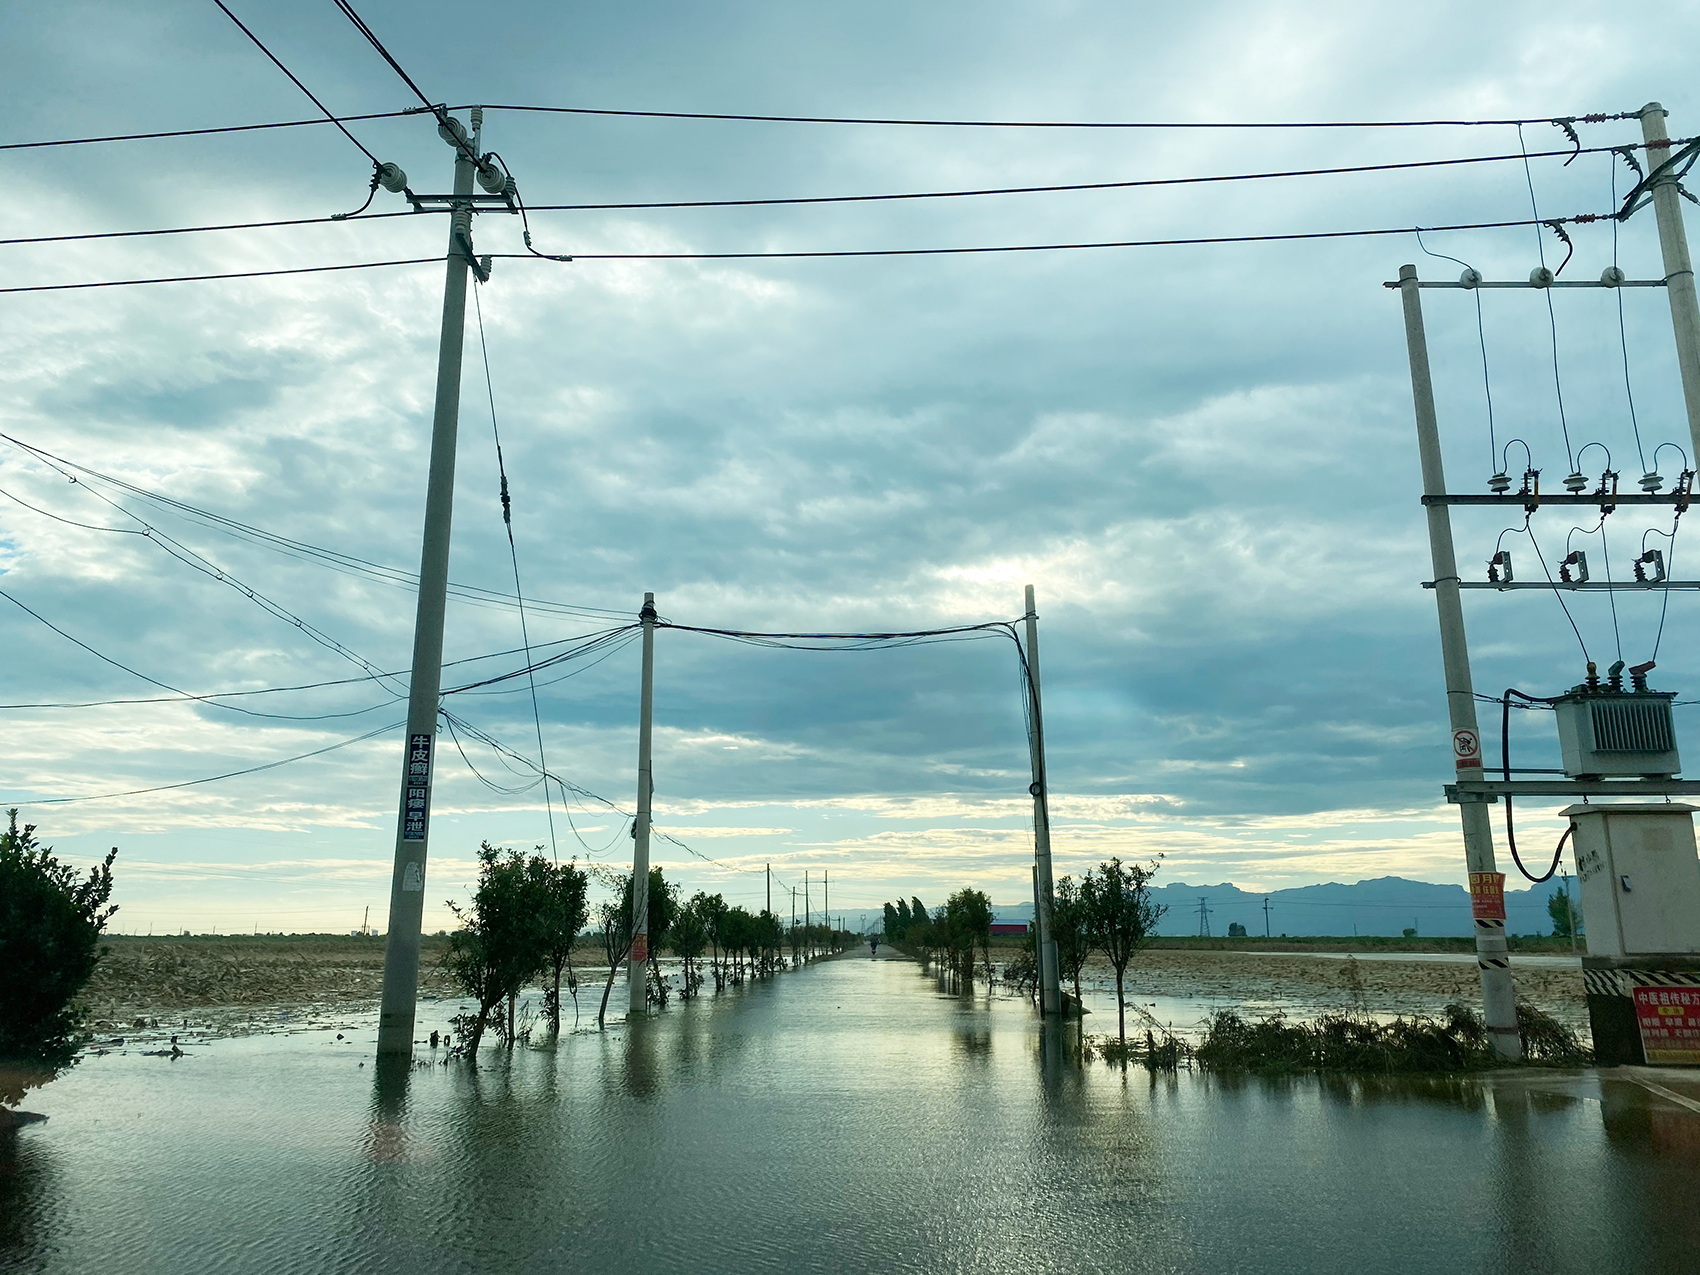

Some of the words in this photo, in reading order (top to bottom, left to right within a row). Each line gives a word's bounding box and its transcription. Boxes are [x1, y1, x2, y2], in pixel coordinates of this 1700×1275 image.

[410, 735, 429, 775] 牛皮癣
[1638, 991, 1700, 1006] 中医祖传秘方
